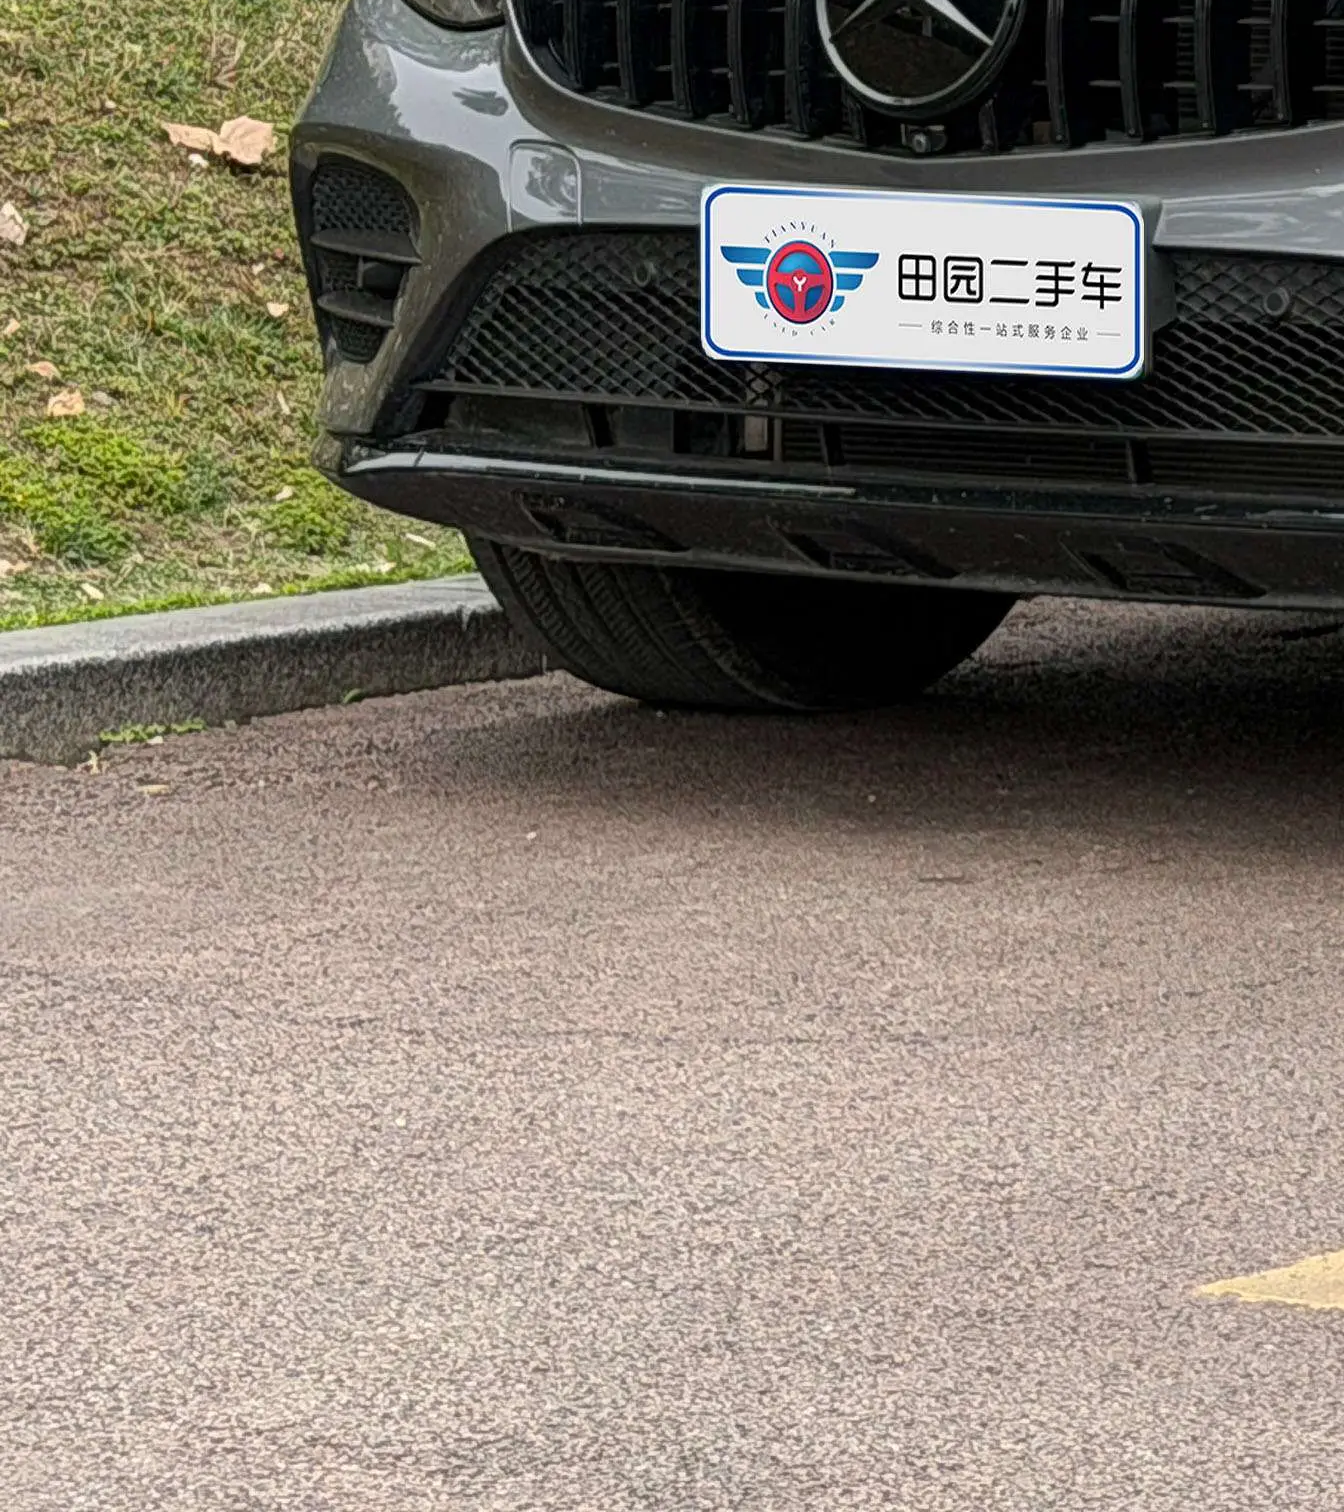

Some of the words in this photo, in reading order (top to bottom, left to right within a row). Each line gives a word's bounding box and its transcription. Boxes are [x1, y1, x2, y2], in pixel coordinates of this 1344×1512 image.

[899, 254, 1122, 309] 田园二手车
[931, 320, 1089, 341] 综合性一站式服务企业
